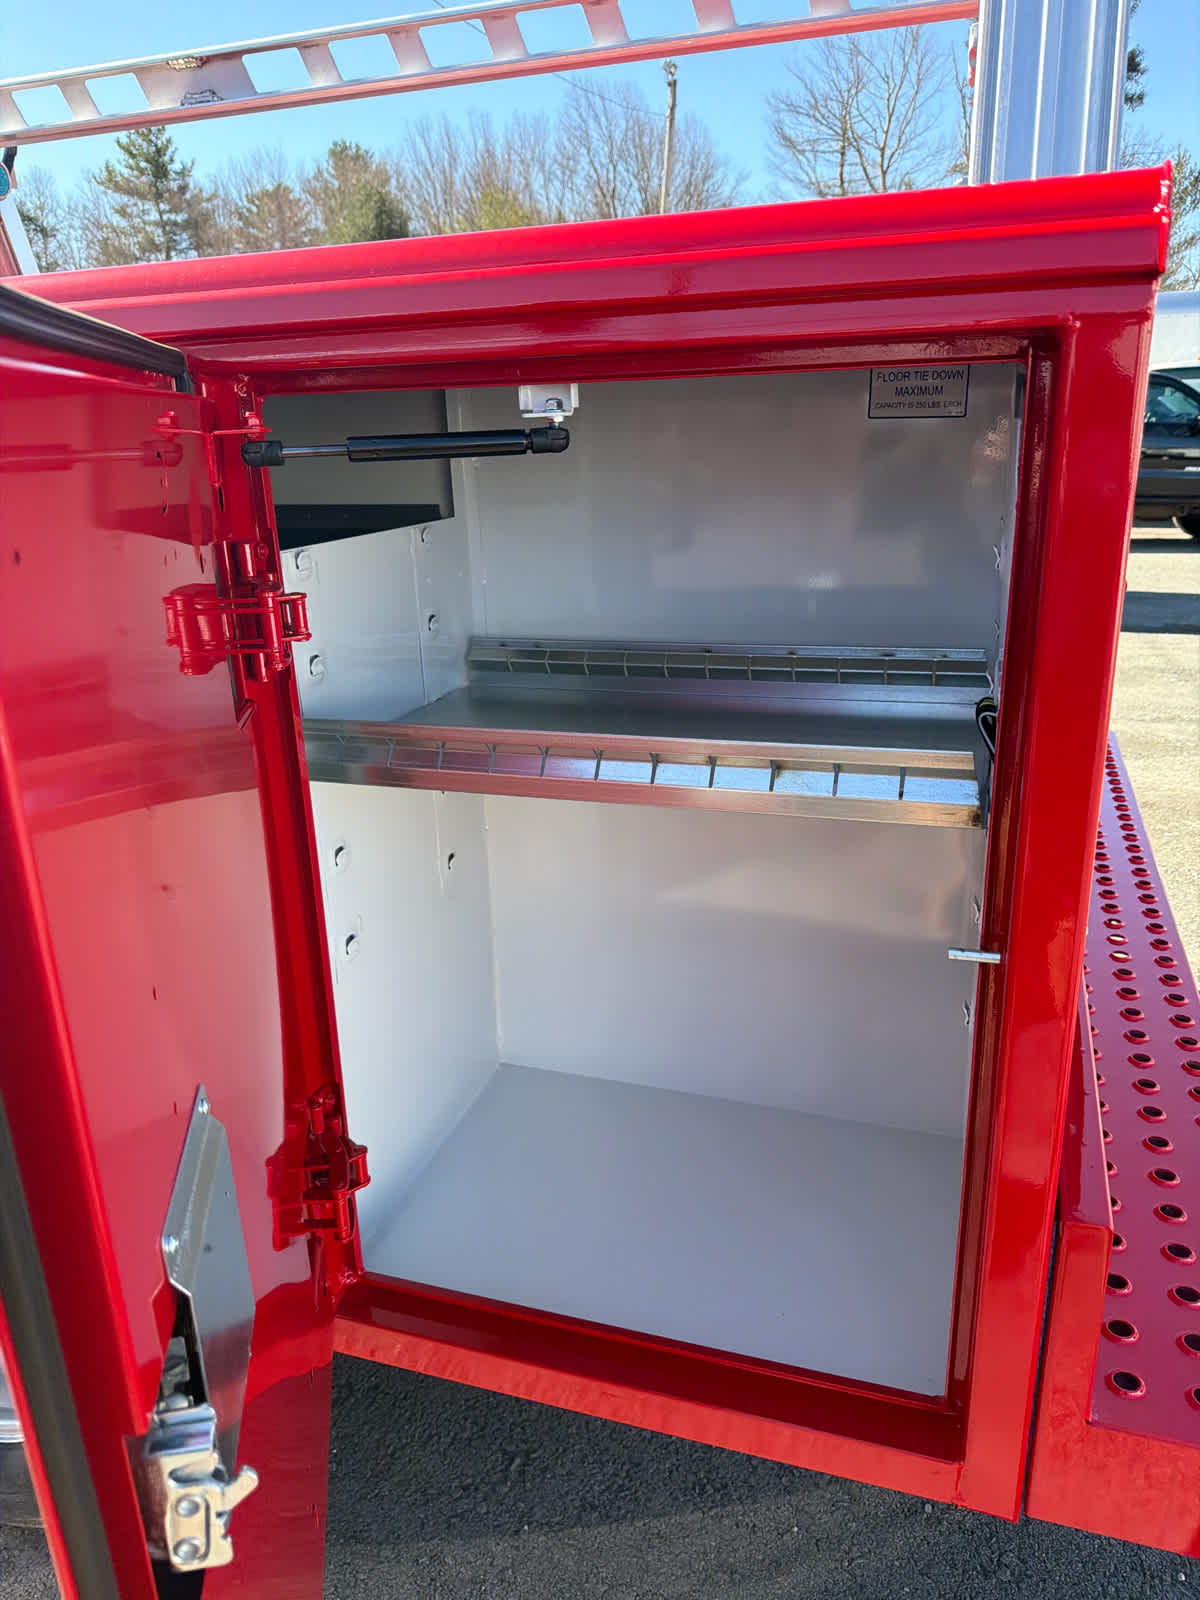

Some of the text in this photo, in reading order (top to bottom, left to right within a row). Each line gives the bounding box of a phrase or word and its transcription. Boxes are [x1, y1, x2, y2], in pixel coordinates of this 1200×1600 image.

[877, 370, 964, 382] FLOOR TIE DOWN
[895, 385, 944, 396] MAXIMUM
